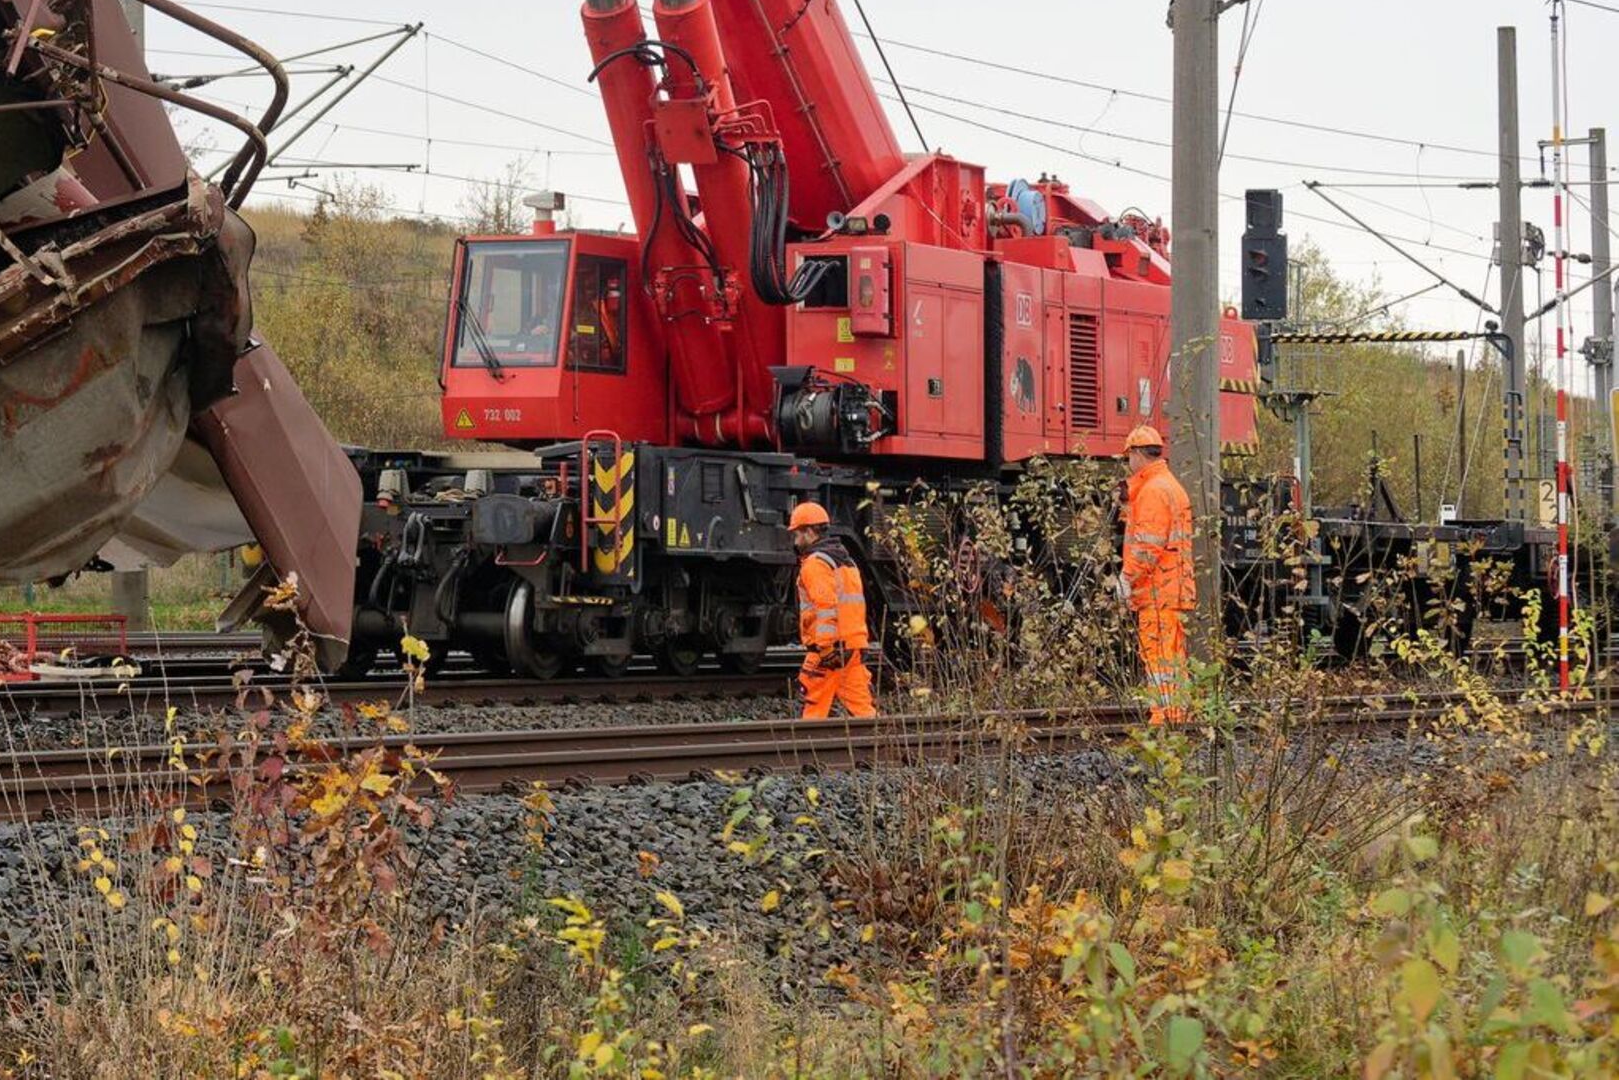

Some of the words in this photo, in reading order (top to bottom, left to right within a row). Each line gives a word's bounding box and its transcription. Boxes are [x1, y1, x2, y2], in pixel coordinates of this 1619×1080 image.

[1018, 295, 1031, 324] DB
[484, 408, 501, 421] 732
[1541, 481, 1555, 502] 2
